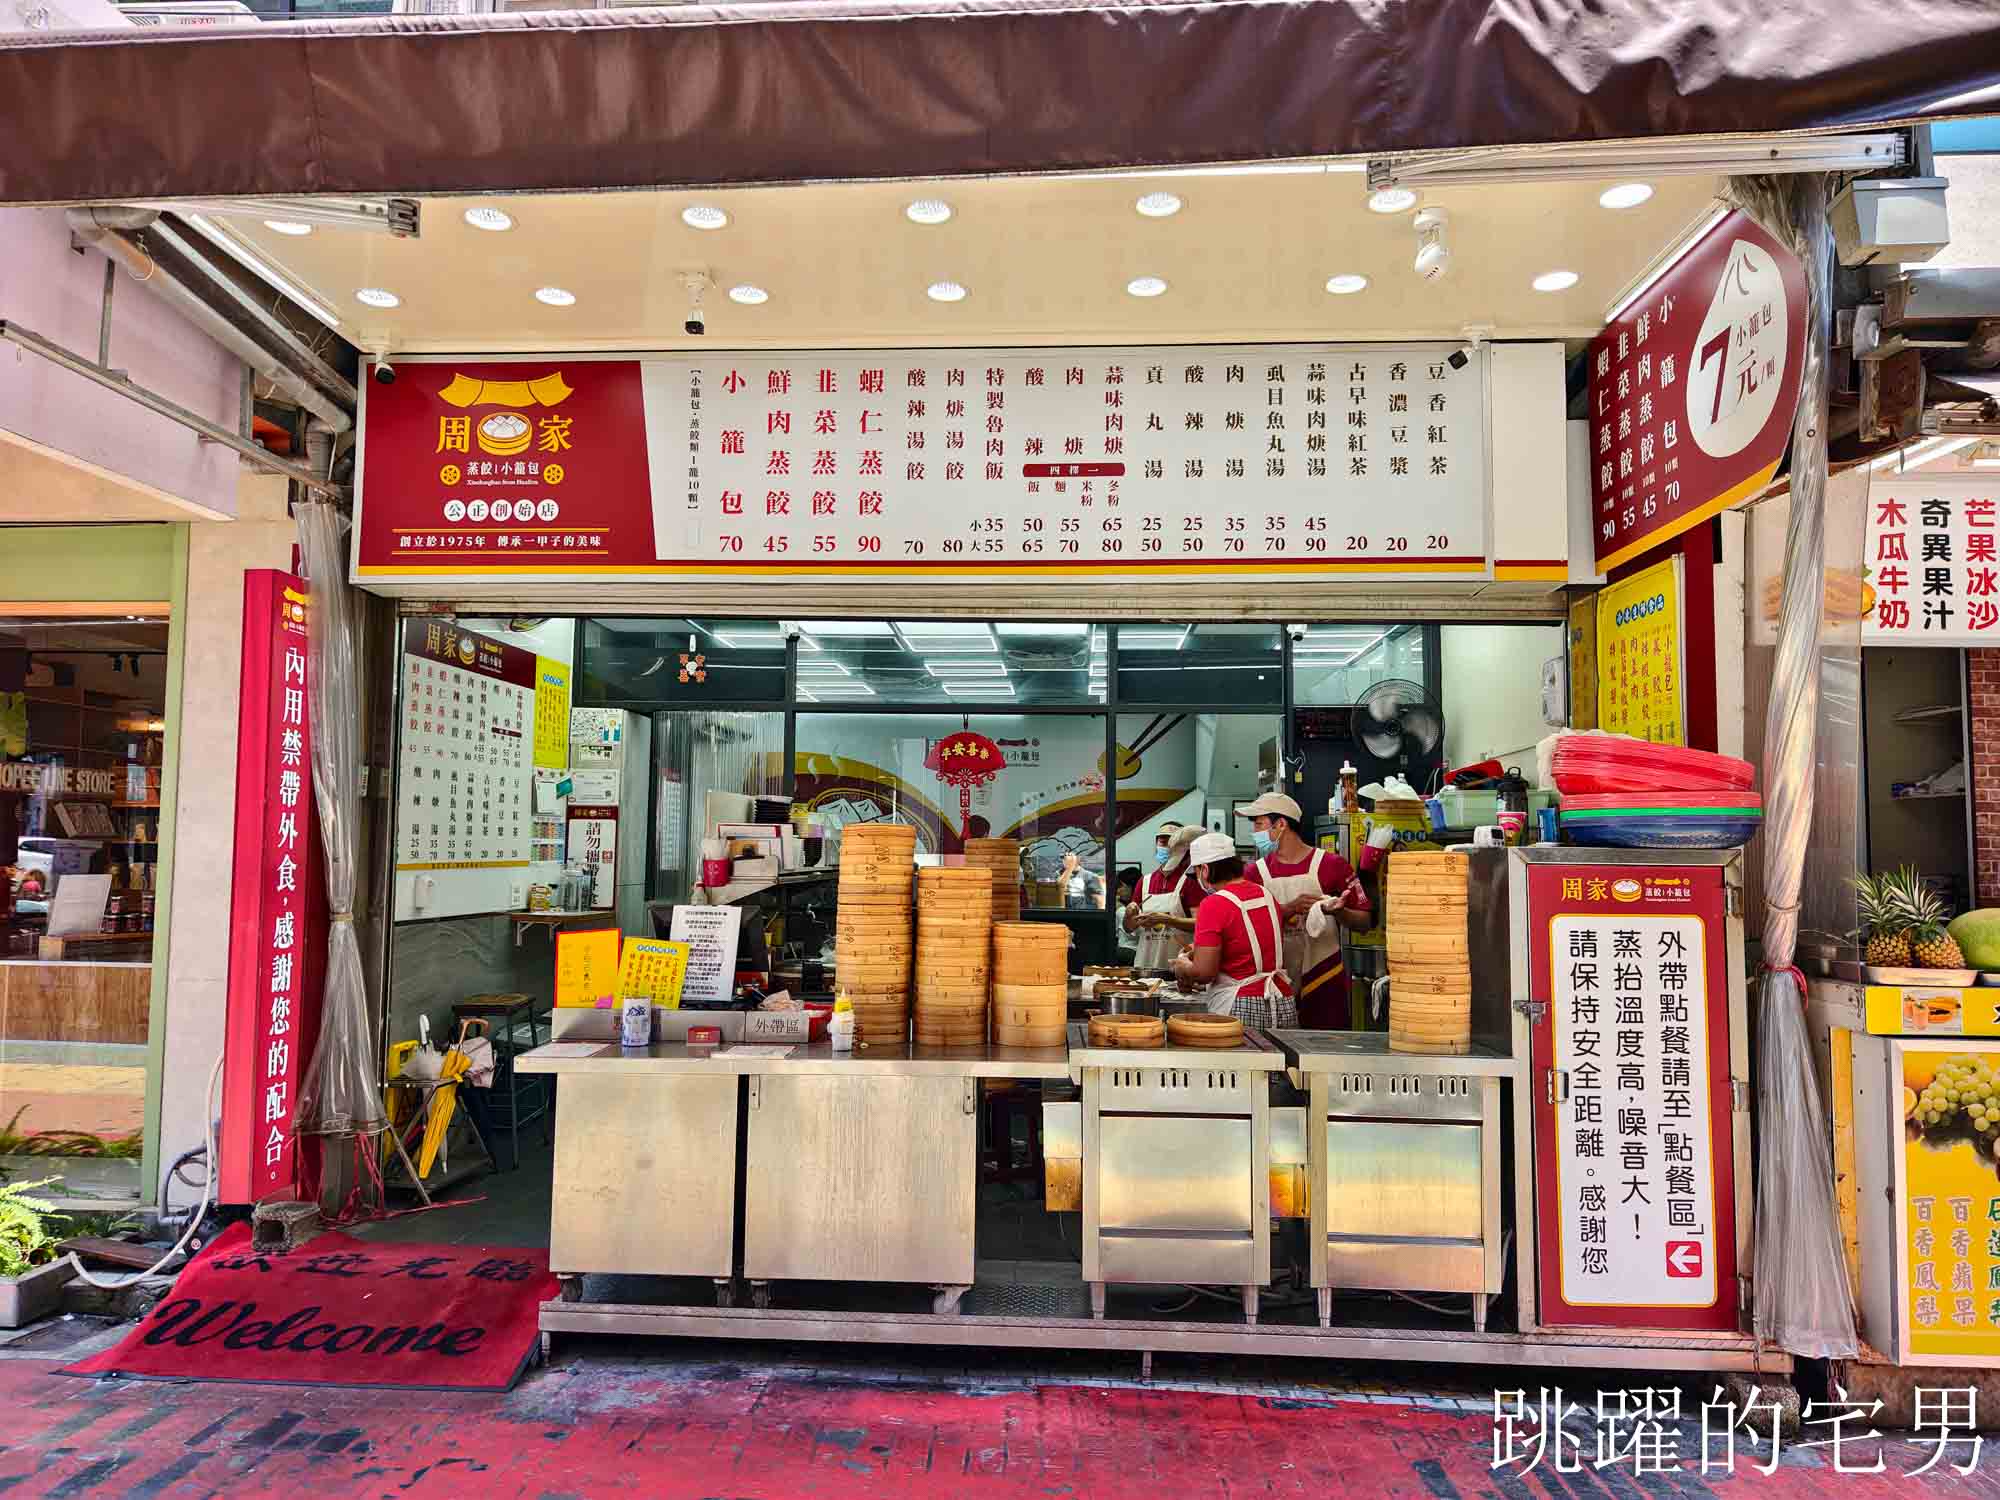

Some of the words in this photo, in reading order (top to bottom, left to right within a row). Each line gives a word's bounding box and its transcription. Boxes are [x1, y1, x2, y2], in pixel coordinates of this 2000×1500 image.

[1736, 303, 1773, 347] 小籠包
[1658, 296, 1677, 449] 小籠包
[1700, 324, 1731, 425] 7
[1636, 312, 1654, 466] 鮮肉蒸餃
[1024, 367, 1044, 456] 酸辣
[1104, 366, 1124, 455] 蒜味肉焿
[1617, 331, 1633, 480] 韭菜蒸餃
[907, 369, 926, 480] 酸辣湯餃
[946, 368, 965, 480] 肉焿湯餃
[986, 367, 1005, 480] 特製魯肉飯
[1184, 365, 1204, 478] 酸辣湯
[1348, 362, 1367, 476] 古早味紅茶
[1388, 362, 1408, 476] 香濃豆漿
[1428, 362, 1448, 475] 豆香紅茶
[1597, 347, 1613, 492] 蝦仁蒸餃
[436, 415, 574, 455] 周家
[720, 370, 745, 514] 小籠包
[767, 370, 792, 514] 鮮肉蒸餃
[812, 369, 837, 514] 韭菜蒸餃
[859, 370, 884, 515] 蝦仁蒸餃
[1050, 465, 1099, 475] 四擇一
[1028, 481, 1040, 493] 飯
[1080, 480, 1092, 507] 米粉
[1107, 480, 1119, 507] 冬粉
[1665, 480, 1680, 504] 70
[448, 502, 555, 517] 公正創始店
[1642, 494, 1656, 518] 45
[969, 520, 982, 532] 小
[984, 518, 1004, 532] 35
[1023, 518, 1043, 532] 50
[1060, 518, 1080, 532] 55
[1102, 518, 1122, 531] 65
[1142, 517, 1162, 531] 25
[1183, 517, 1203, 531] 25
[1225, 517, 1245, 532] 35
[1265, 516, 1286, 531] 35
[1304, 517, 1326, 531] 45
[1622, 507, 1635, 529] 55
[1603, 519, 1616, 541] 90
[400, 535, 486, 548] 創立於1975年
[497, 535, 601, 547] 傳承一甲子的美味
[719, 536, 743, 553] 70
[764, 536, 788, 553] 45
[812, 536, 836, 553] 55
[858, 536, 881, 553] 90
[904, 540, 924, 554] 70
[943, 539, 963, 553] 80
[970, 541, 982, 553] 大
[984, 539, 1004, 553] 55
[1022, 539, 1043, 553] 65
[1059, 539, 1079, 553] 70
[1102, 538, 1122, 552] 80
[1141, 538, 1162, 552] 50
[1183, 538, 1203, 552] 50
[1224, 537, 1244, 552] 70
[1265, 537, 1286, 551] 70
[1305, 537, 1326, 552] 90
[1346, 536, 1368, 551] 20
[1386, 537, 1408, 552] 20
[1426, 535, 1449, 550] 20
[1877, 498, 1910, 629] 木瓜牛奶
[1920, 498, 1955, 630] 奇異果汁
[1965, 499, 1999, 631] 芒果冰沙
[1561, 877, 1609, 901] 周家
[754, 1016, 799, 1034] 外帶區
[1912, 1196, 1940, 1325] 百香鳳梨
[1947, 1196, 1977, 1325] 百香蘋果
[143, 1299, 485, 1357] Welcome
